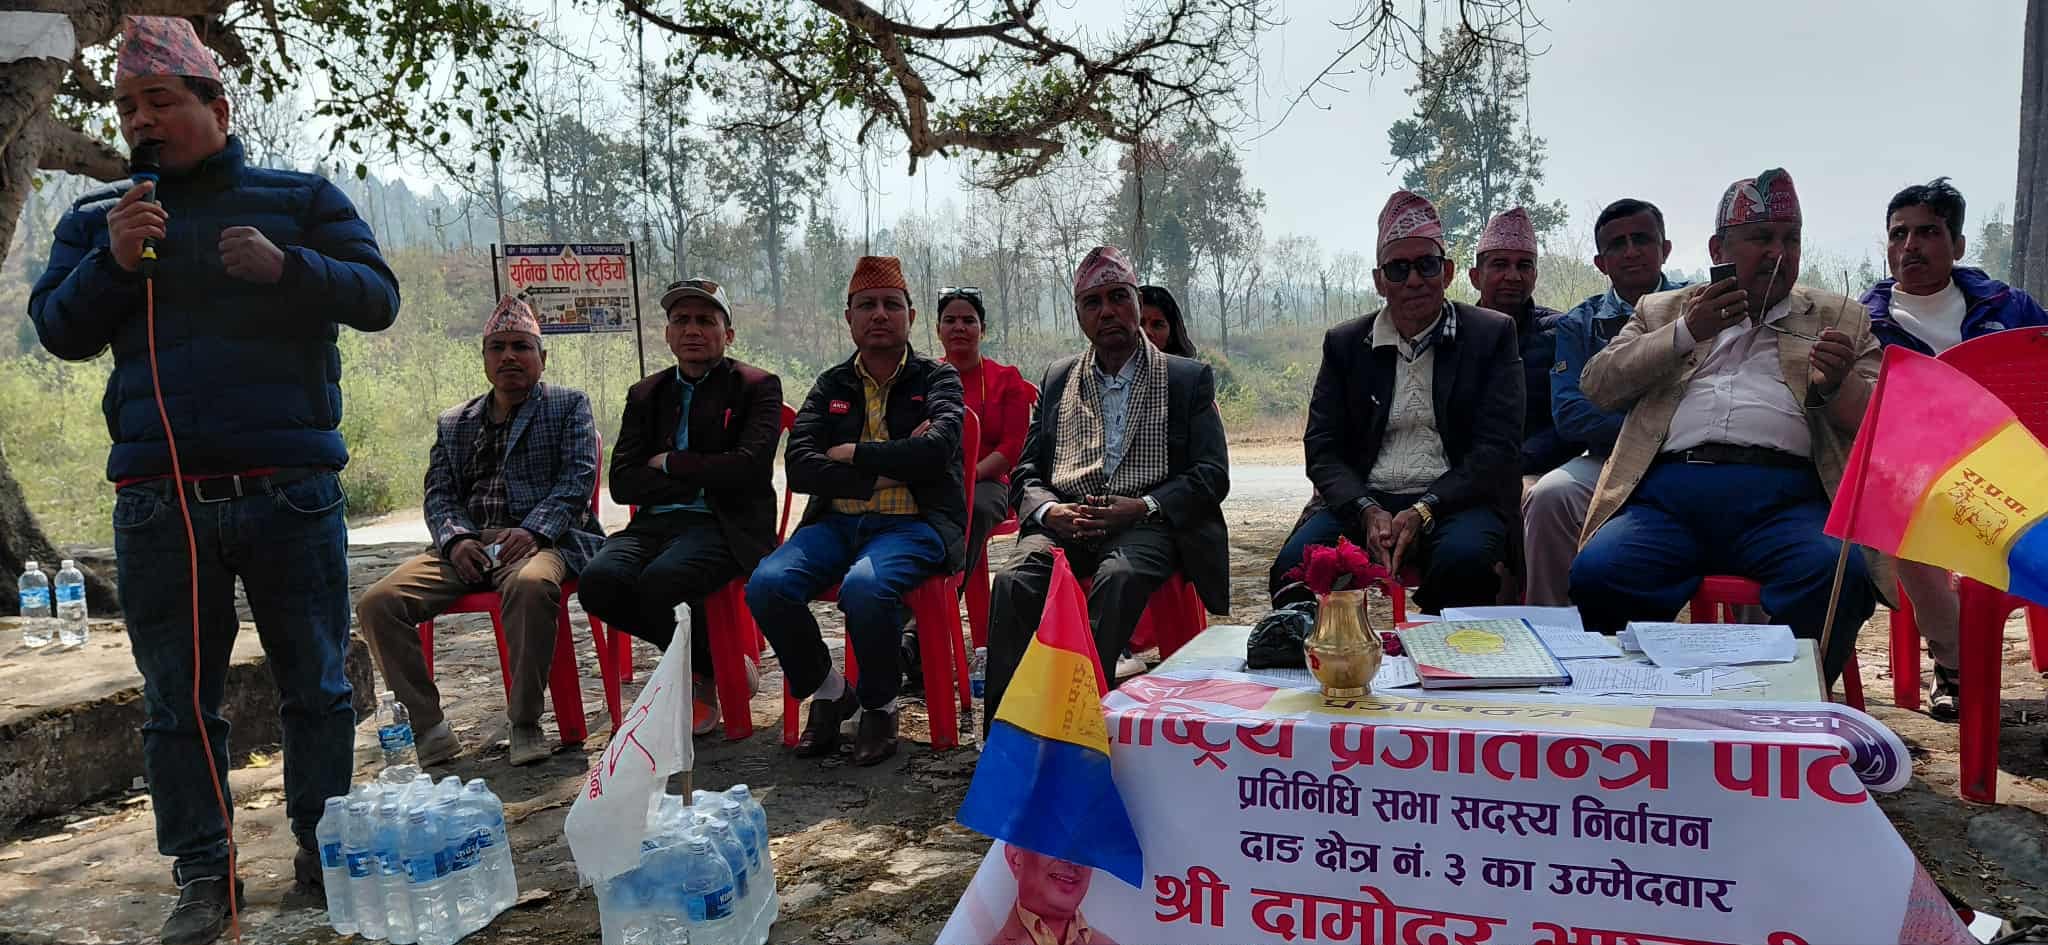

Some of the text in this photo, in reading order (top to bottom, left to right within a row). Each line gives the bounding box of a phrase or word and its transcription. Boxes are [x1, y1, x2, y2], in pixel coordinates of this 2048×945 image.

[510, 256, 626, 288] युनिक फोटो स्टुडियो
[1238, 767, 1712, 849] प्रतिनिधि सभा सदस्य निर्वाचन
[1154, 865, 1231, 928] श्री
[1239, 830, 1736, 913] दाङ क्षेत्र नं. ३ का उम्मेदवार
